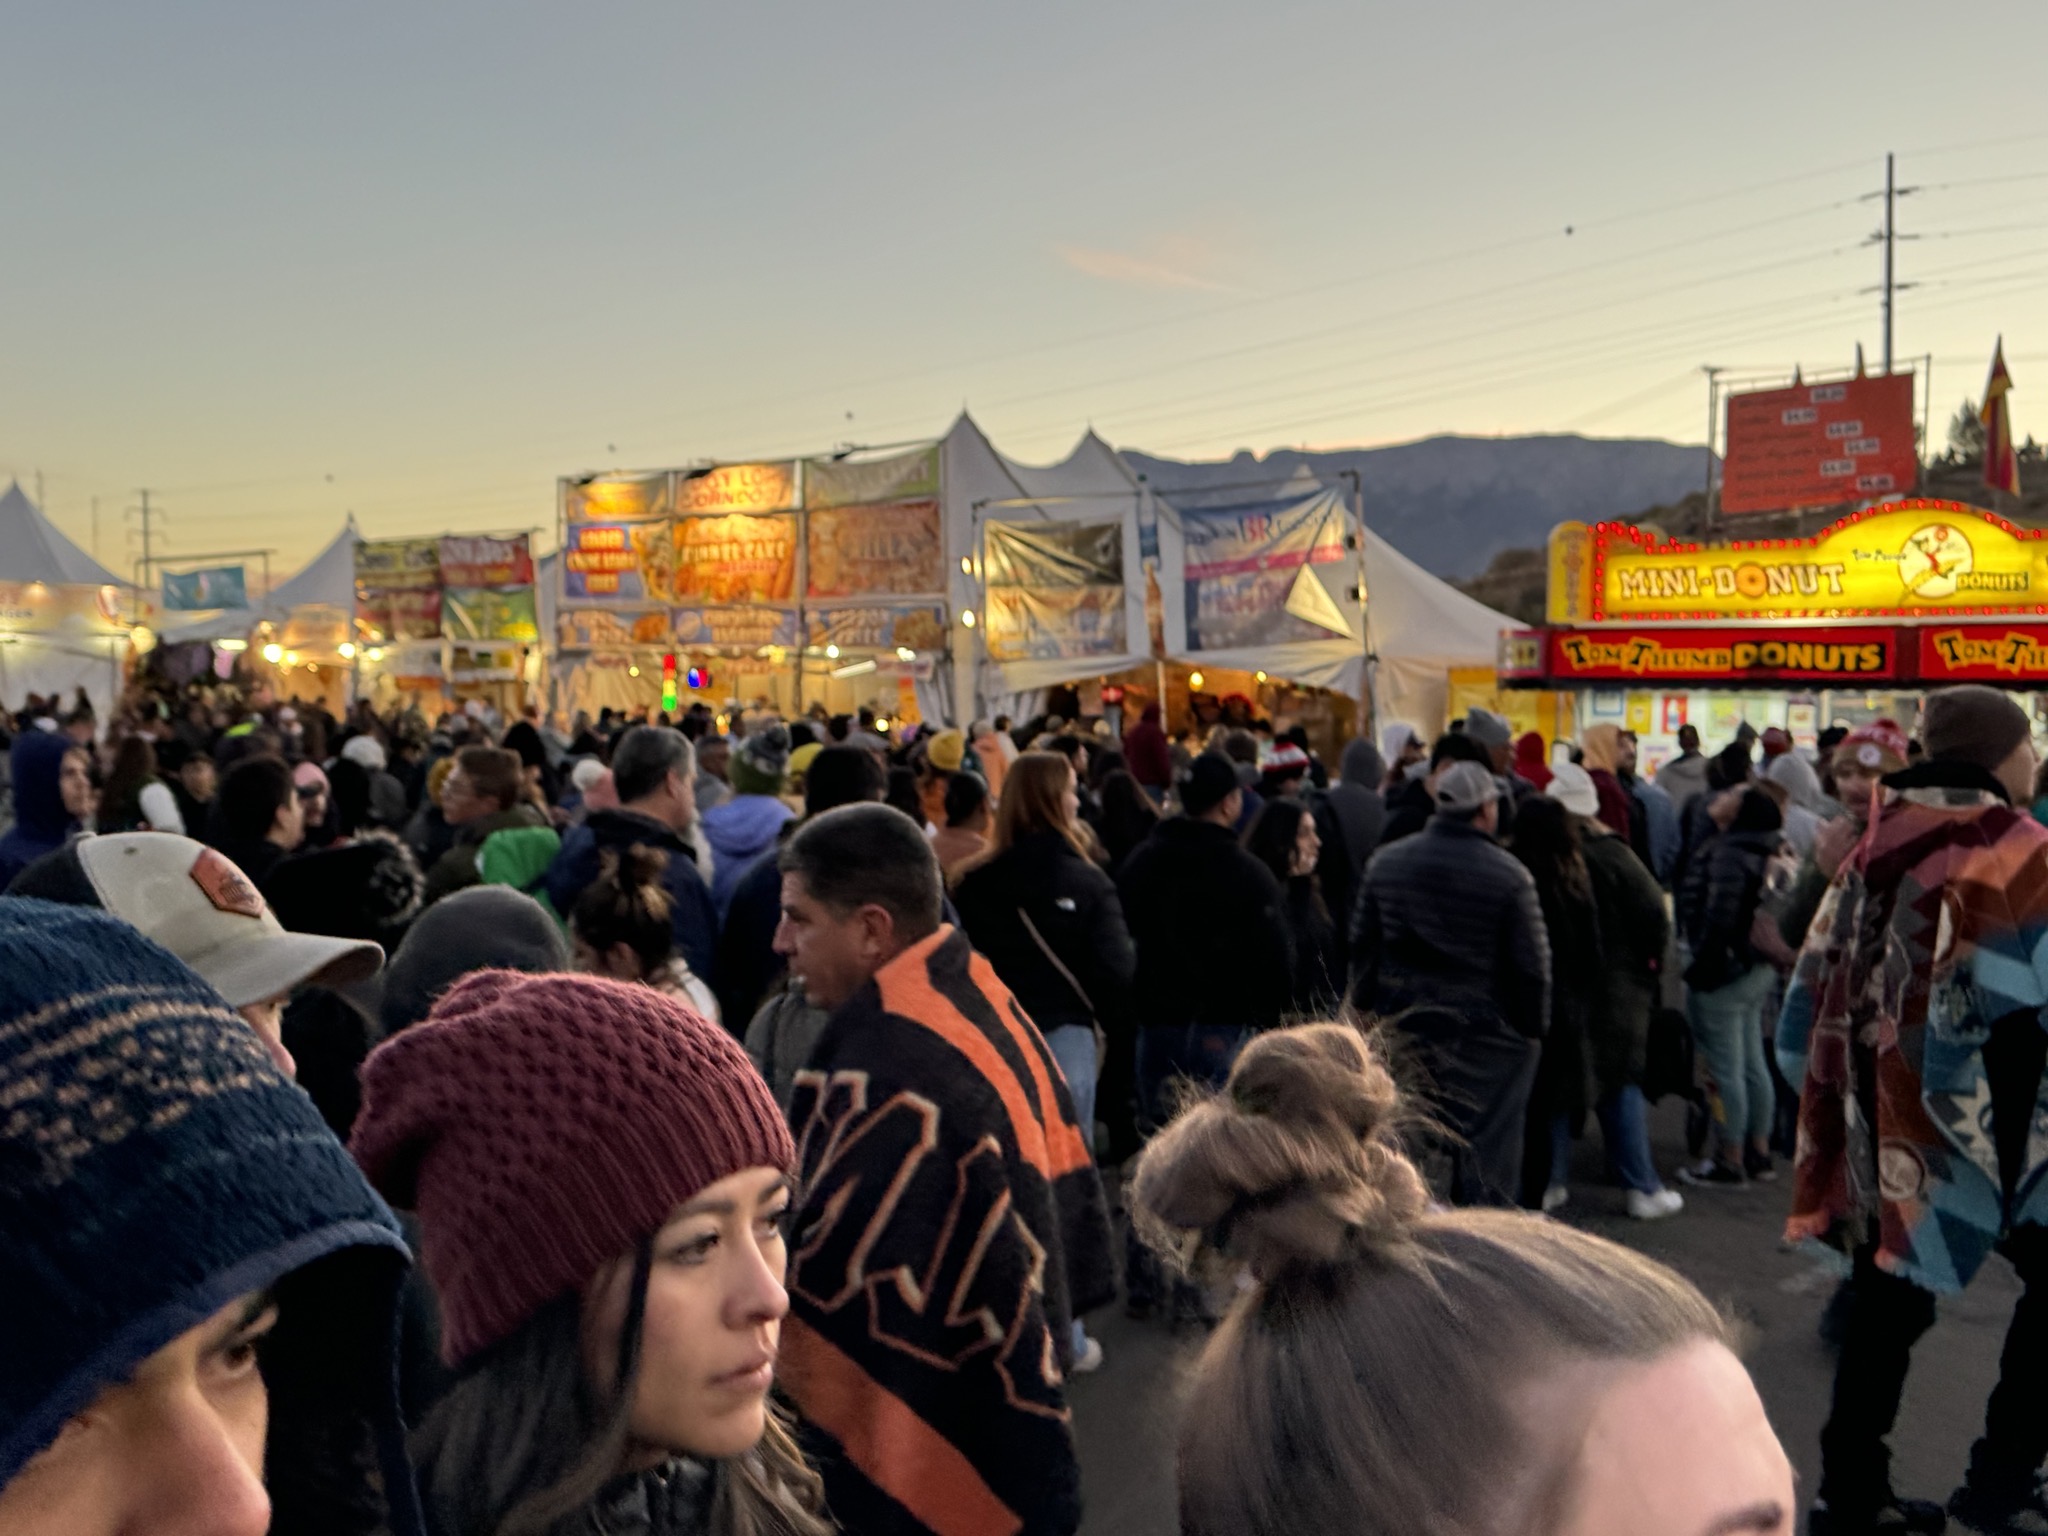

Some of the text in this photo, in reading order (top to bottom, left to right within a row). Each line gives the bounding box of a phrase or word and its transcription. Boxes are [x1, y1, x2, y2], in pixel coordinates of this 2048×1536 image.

[1617, 562, 1845, 599] MINI-DONUT
[1957, 573, 2028, 592] DONUTS
[1732, 642, 1884, 670] DONUTS
